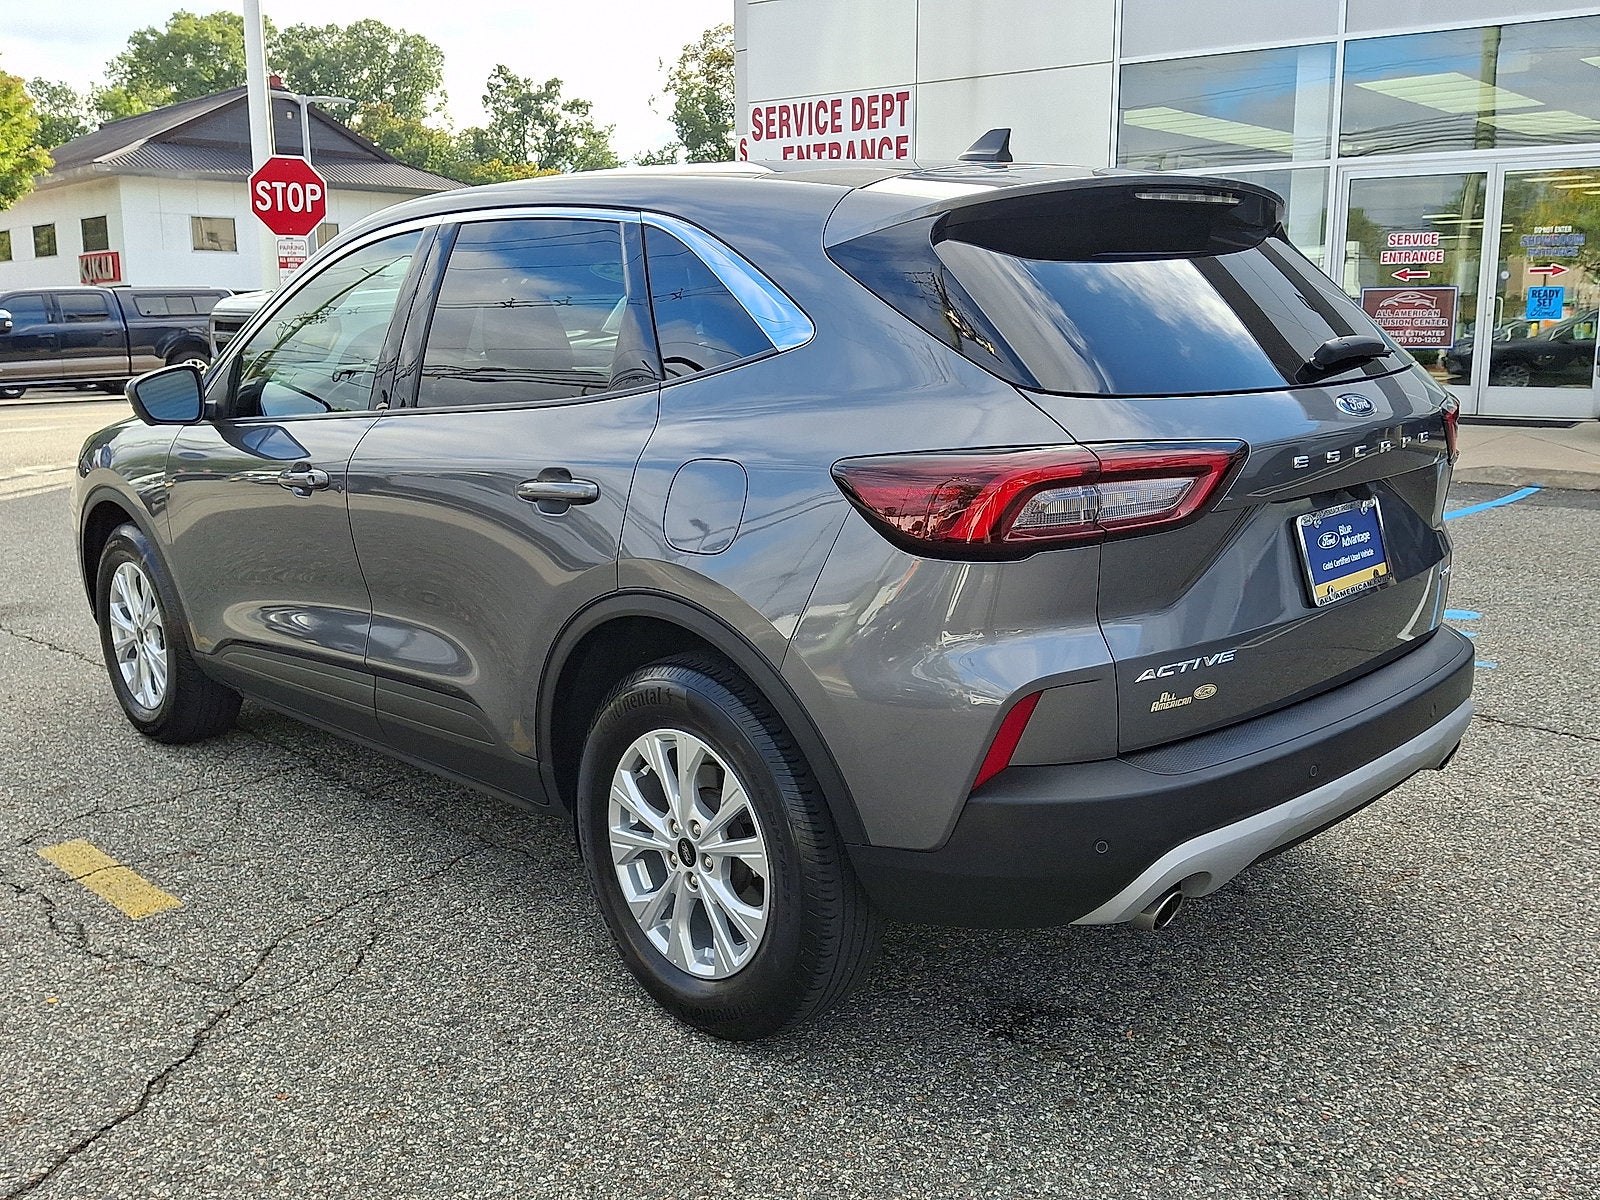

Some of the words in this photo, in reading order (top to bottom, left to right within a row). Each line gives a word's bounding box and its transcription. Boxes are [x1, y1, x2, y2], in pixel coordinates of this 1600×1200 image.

[752, 99, 842, 141] SERVICE
[852, 91, 910, 132] DEPT
[255, 181, 322, 213] STOP
[1388, 233, 1439, 246] SERVICE
[1521, 234, 1585, 246] SHOWROOM
[1381, 250, 1444, 263] ENTRANCE
[1531, 289, 1560, 298] READY
[1375, 309, 1392, 317] ALL
[1394, 309, 1440, 317] AMERICAN
[1374, 319, 1411, 327] OLLISION
[1412, 318, 1449, 327] CENTER
[1346, 398, 1371, 411] Ford
[1292, 431, 1429, 469] ESCAPE
[1338, 524, 1353, 536] Blue
[1341, 531, 1371, 548] Advantage
[1322, 562, 1333, 570] Gold
[1334, 555, 1350, 567] Certified
[1350, 552, 1361, 562] Used
[1361, 548, 1374, 558] Vehicle
[1335, 581, 1372, 600] AMERICAN
[1134, 649, 1238, 683] ACTIVE
